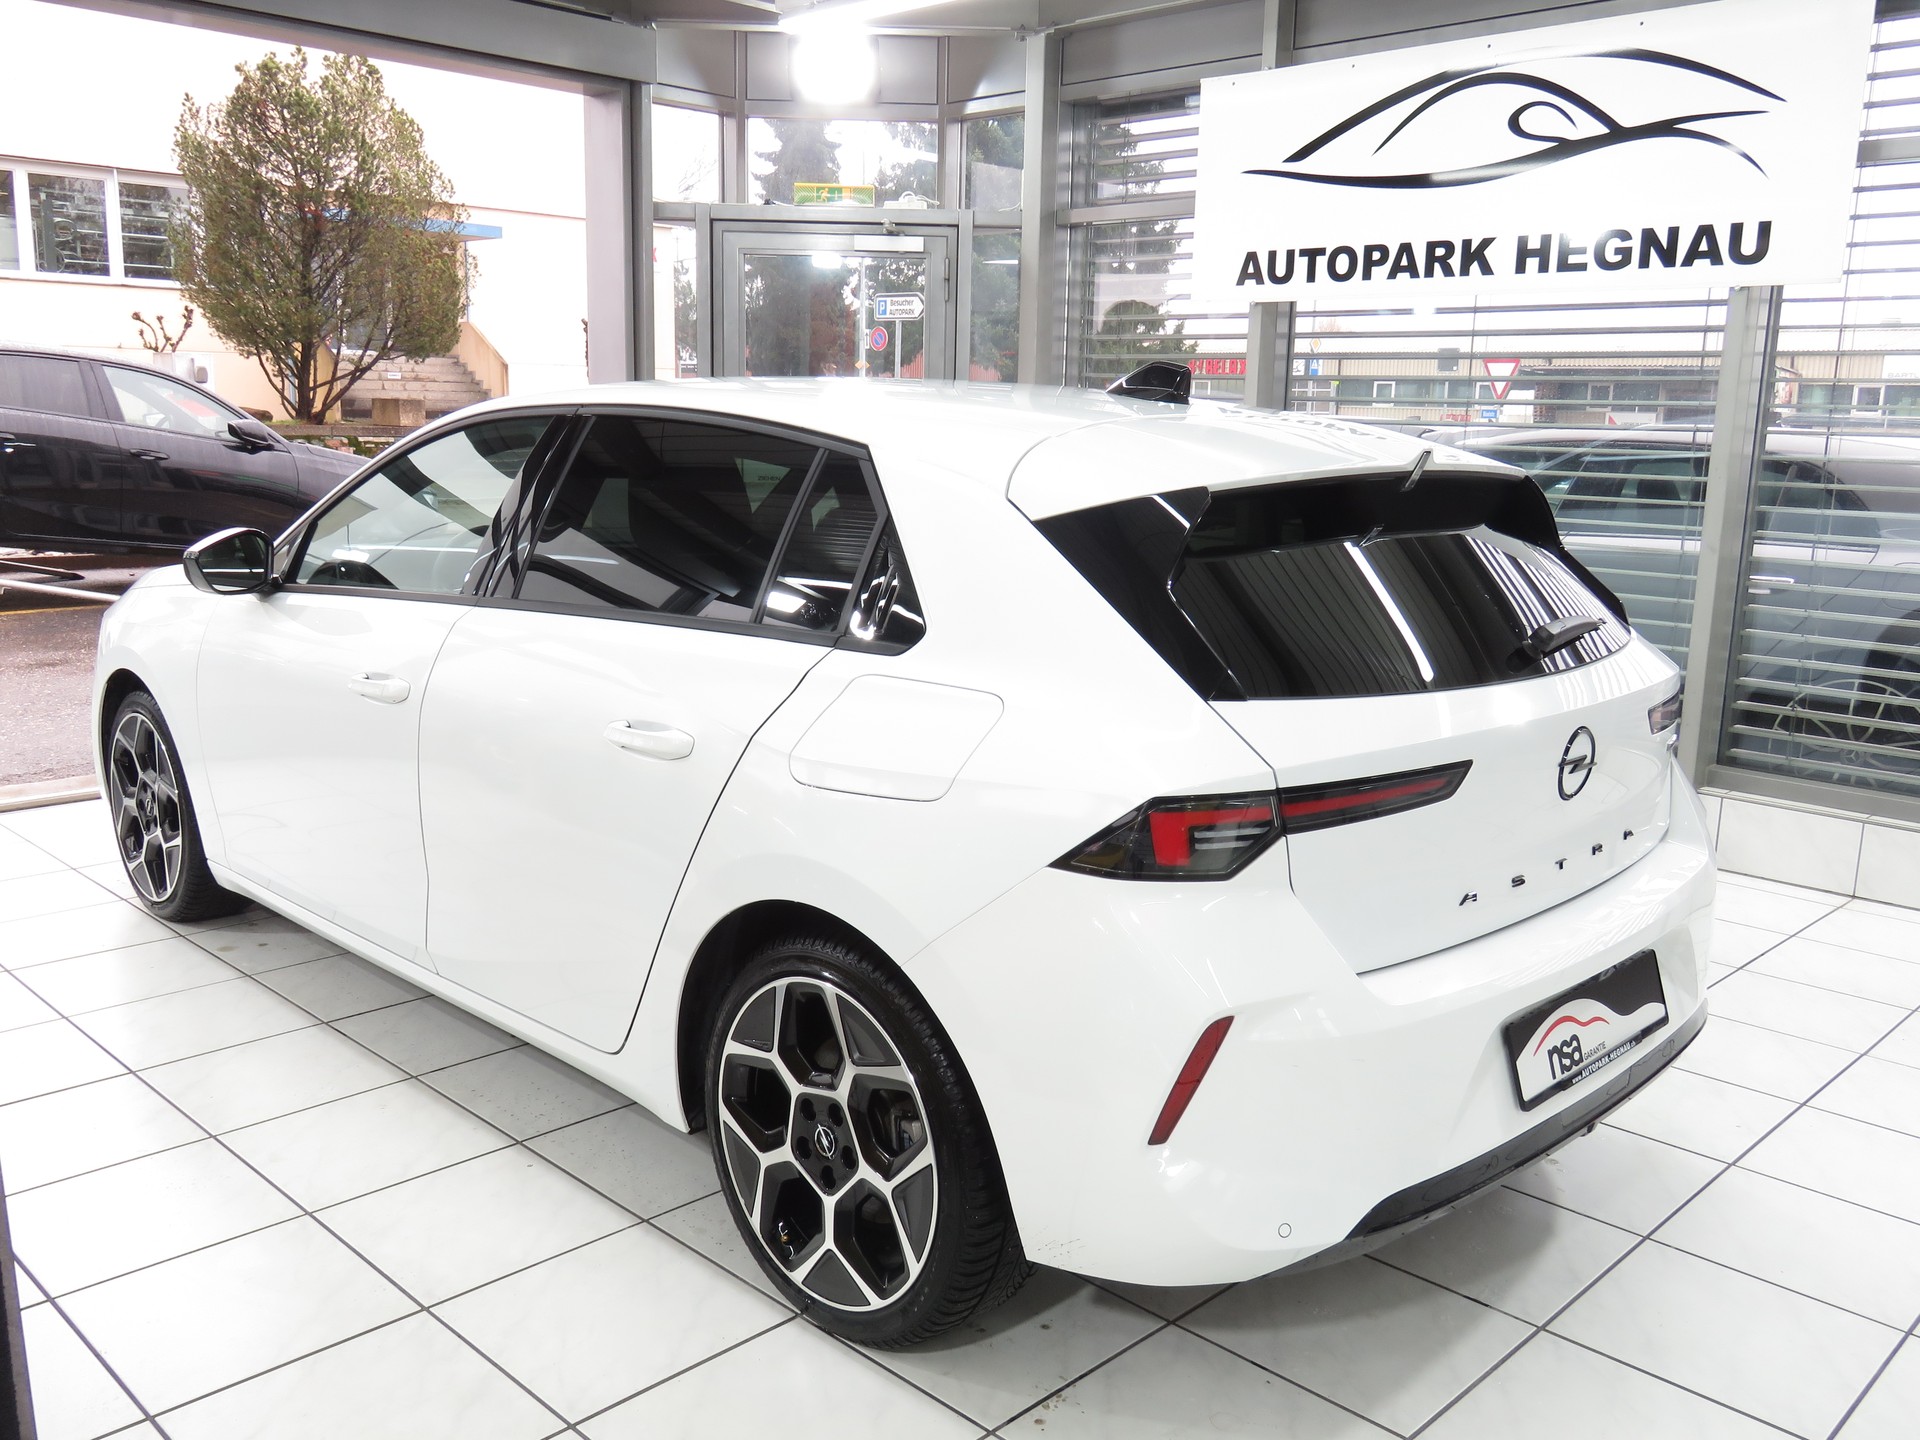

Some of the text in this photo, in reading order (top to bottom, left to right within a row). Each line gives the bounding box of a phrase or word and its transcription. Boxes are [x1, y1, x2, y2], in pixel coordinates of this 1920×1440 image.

[1236, 220, 1773, 286] AUTOPARK HEGNAU
[889, 299, 914, 307] Besucher
[889, 308, 915, 316] AUTOPARK
[1459, 829, 1634, 906] ASTRA
[1547, 1033, 1607, 1080] nsa GARANTIE
